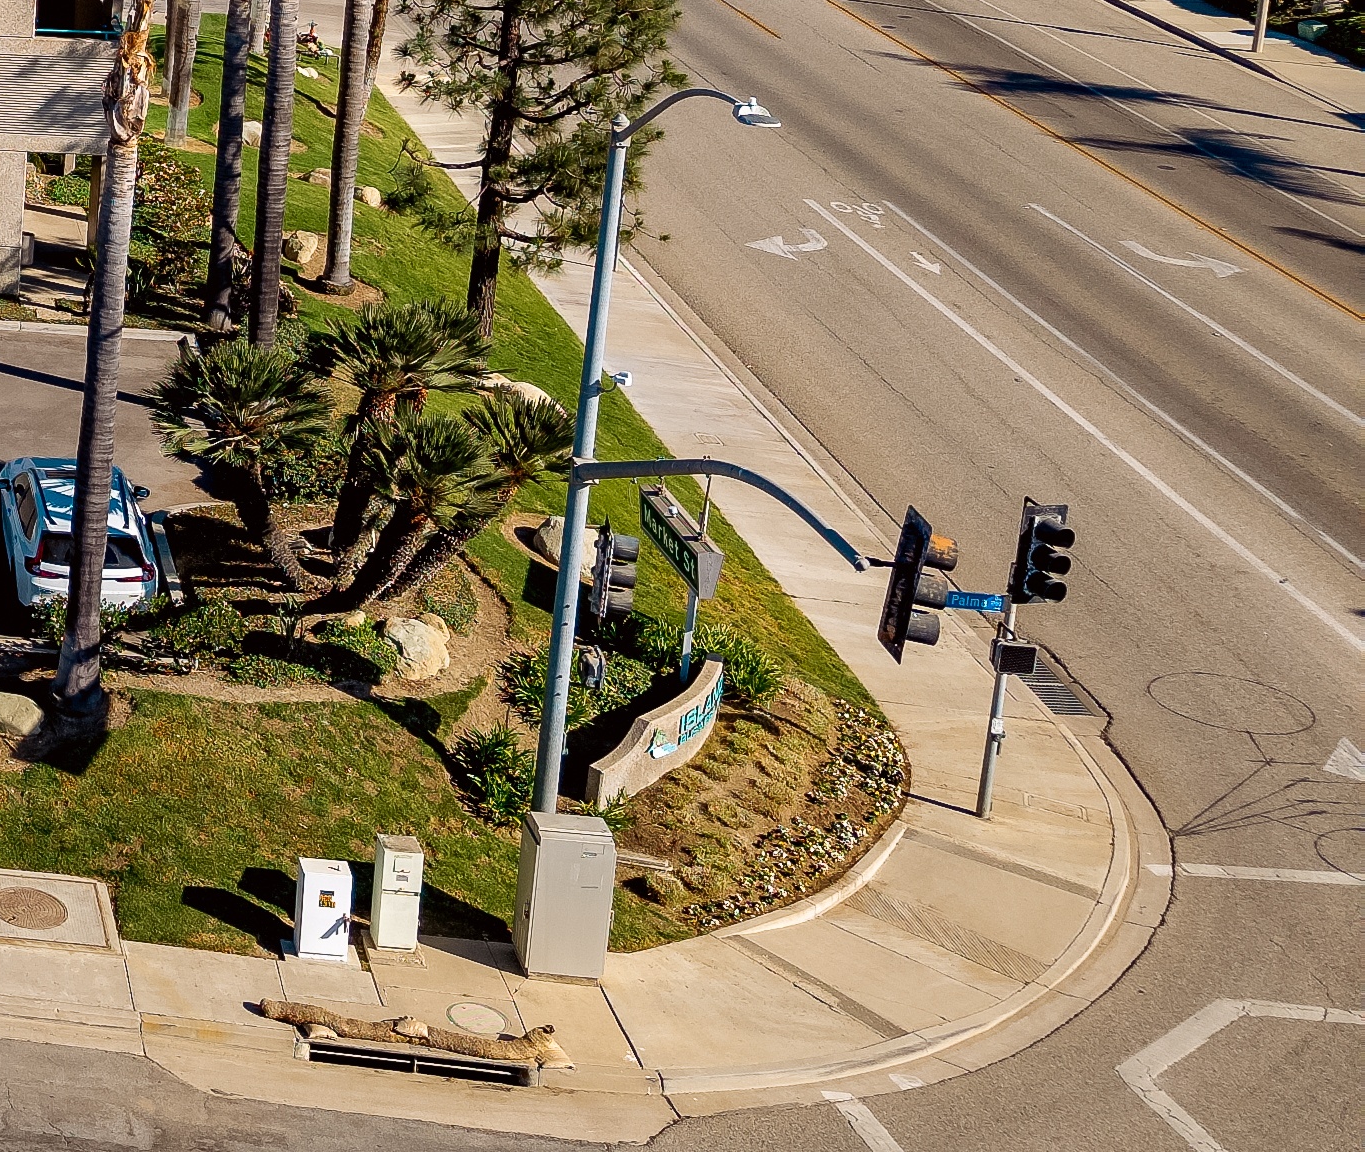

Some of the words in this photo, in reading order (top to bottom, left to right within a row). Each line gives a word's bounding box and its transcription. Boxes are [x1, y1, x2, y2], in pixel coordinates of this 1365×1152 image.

[644, 504, 680, 561] Market
[683, 550, 696, 580] St
[951, 594, 988, 608] Palma
